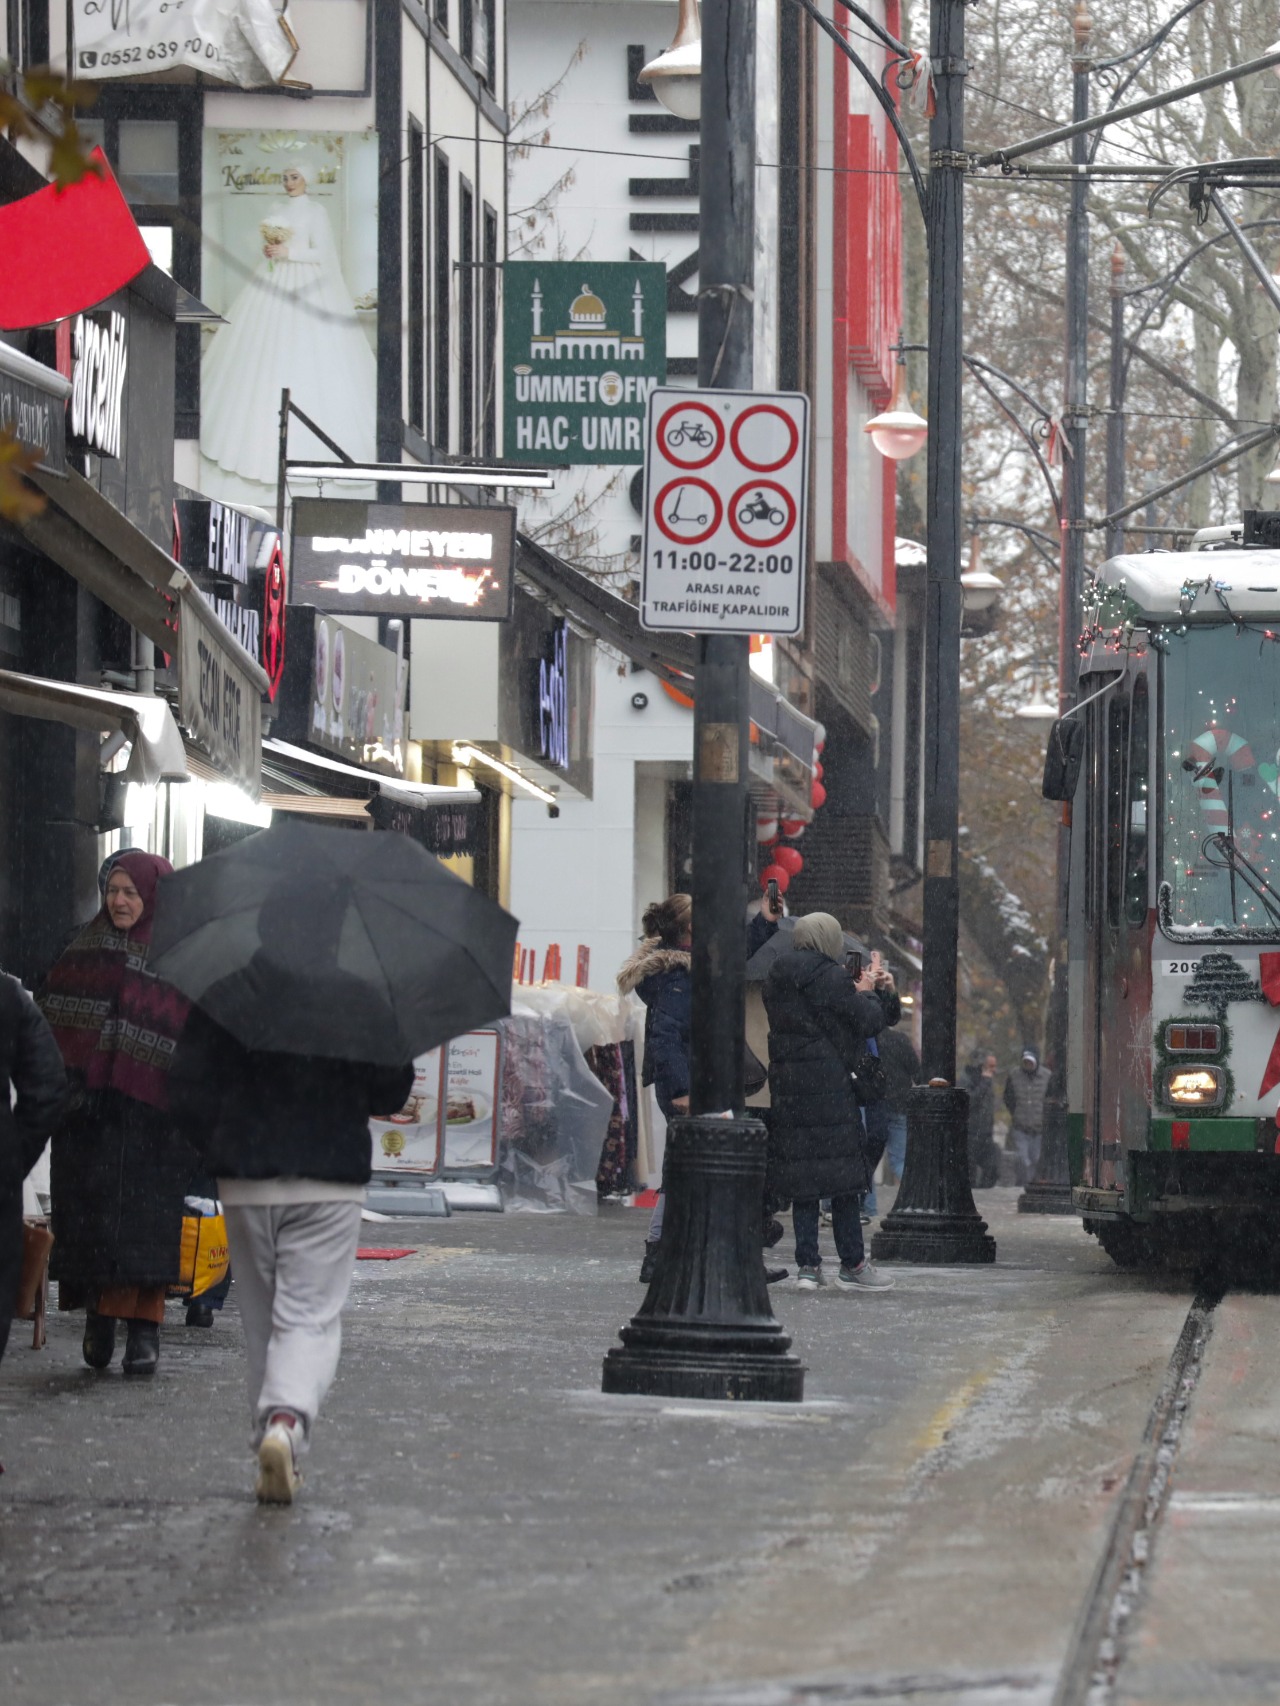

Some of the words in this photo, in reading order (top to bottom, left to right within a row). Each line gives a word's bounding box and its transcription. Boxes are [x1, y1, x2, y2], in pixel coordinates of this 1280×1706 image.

[101, 47, 141, 66] 0552
[147, 42, 178, 60] 639
[624, 376, 657, 403] FM
[516, 416, 569, 450] HAC
[582, 416, 645, 451] UMR
[653, 549, 793, 574] 11:00-22:00
[685, 583, 724, 595] ARASI
[726, 584, 761, 597] ARAÇ
[652, 599, 719, 614] TRAFİĞİNE
[722, 603, 790, 617] KAPALIDIR
